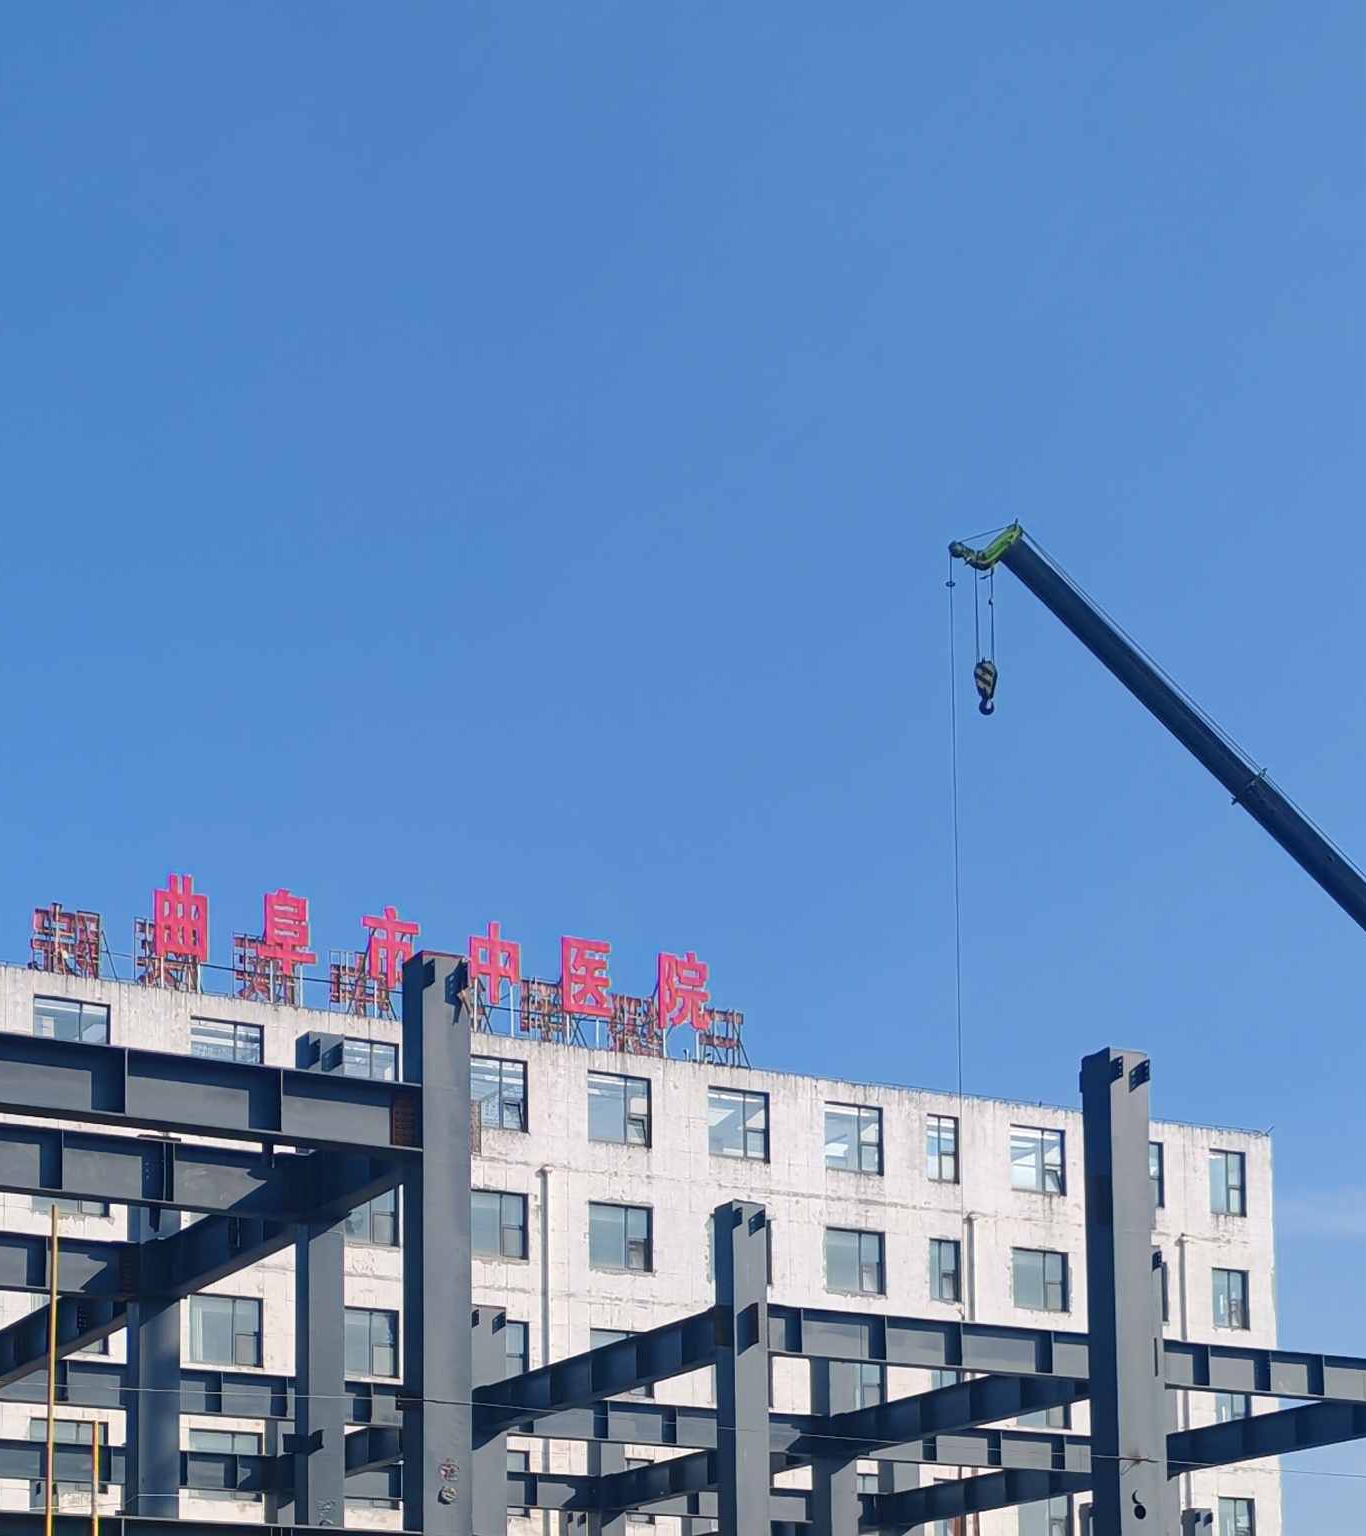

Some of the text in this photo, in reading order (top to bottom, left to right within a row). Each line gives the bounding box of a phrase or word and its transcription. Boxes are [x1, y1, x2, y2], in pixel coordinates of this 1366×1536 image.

[153, 872, 713, 1031] 曲阜市中医院
